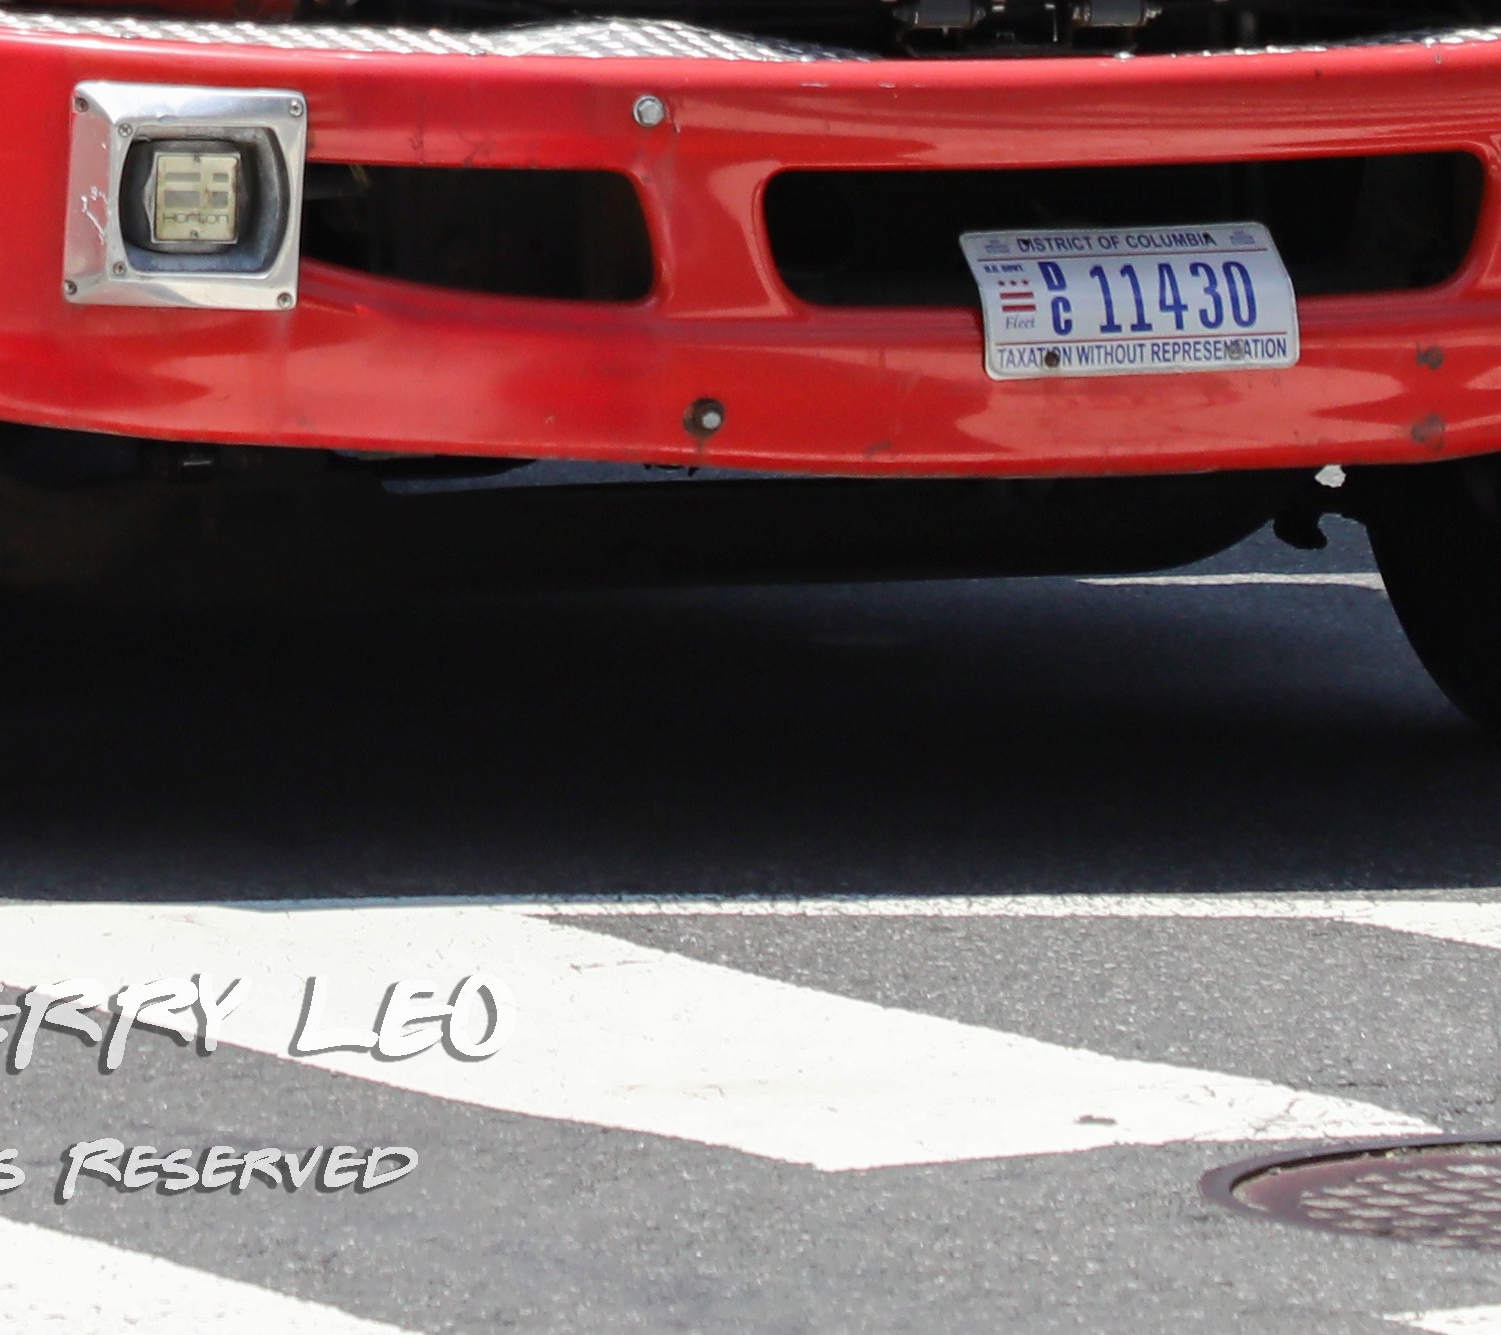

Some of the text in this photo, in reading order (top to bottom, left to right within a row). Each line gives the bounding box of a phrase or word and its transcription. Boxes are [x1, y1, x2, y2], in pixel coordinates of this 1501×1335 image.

[163, 213, 230, 224] Horton
[1017, 232, 1217, 253] DISTRICT OF COLUMBIA
[1089, 260, 1257, 334] 11430
[1005, 316, 1036, 330] Fleet
[1077, 343, 1146, 366] WITHOUT
[1151, 338, 1287, 363] REPRESENATION
